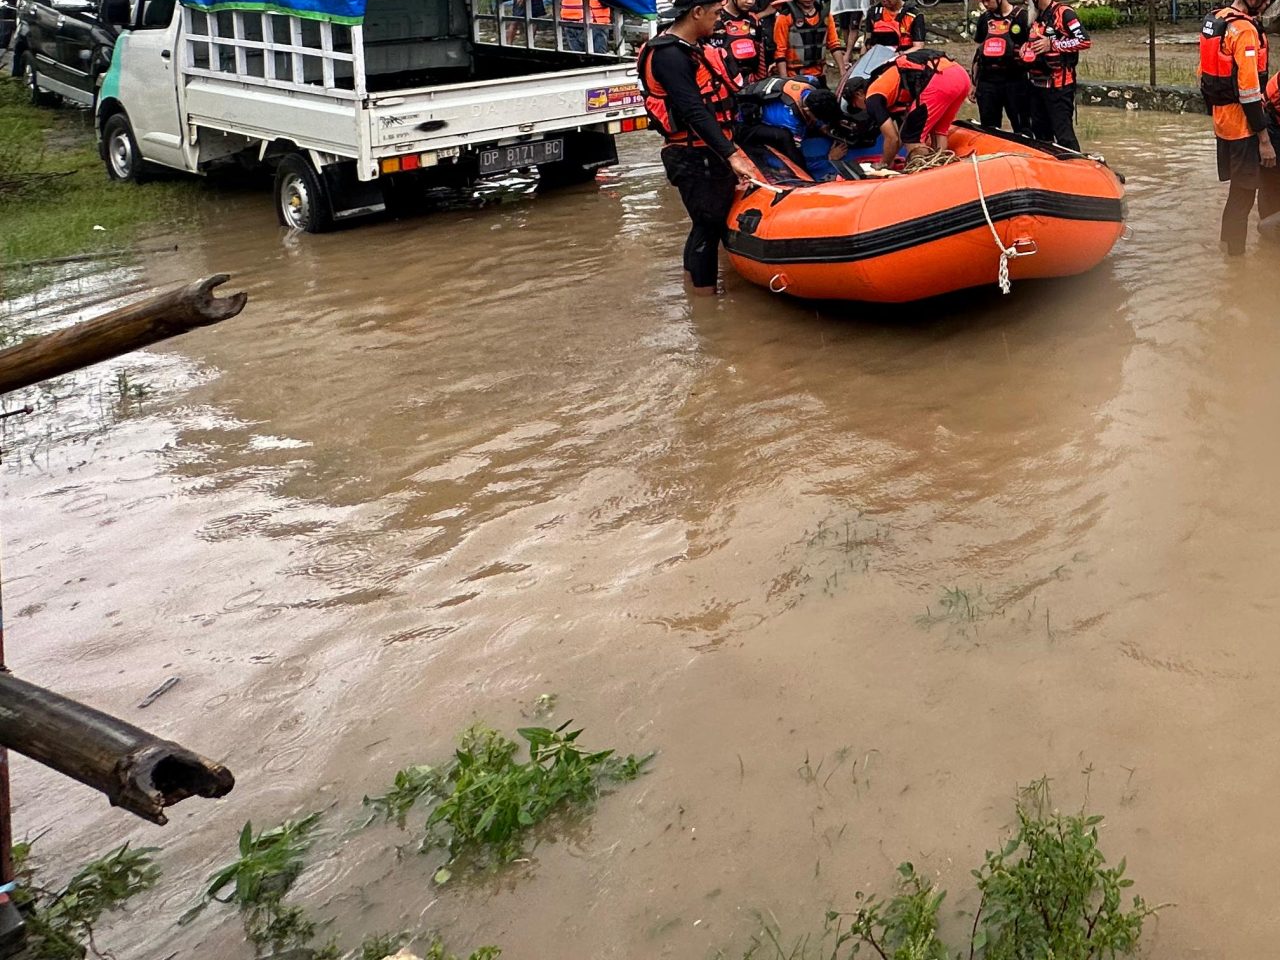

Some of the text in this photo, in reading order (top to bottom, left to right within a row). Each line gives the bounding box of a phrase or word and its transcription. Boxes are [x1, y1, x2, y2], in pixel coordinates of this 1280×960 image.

[484, 151, 499, 166] DP
[507, 145, 534, 161] 8171
[545, 141, 559, 155] BC
